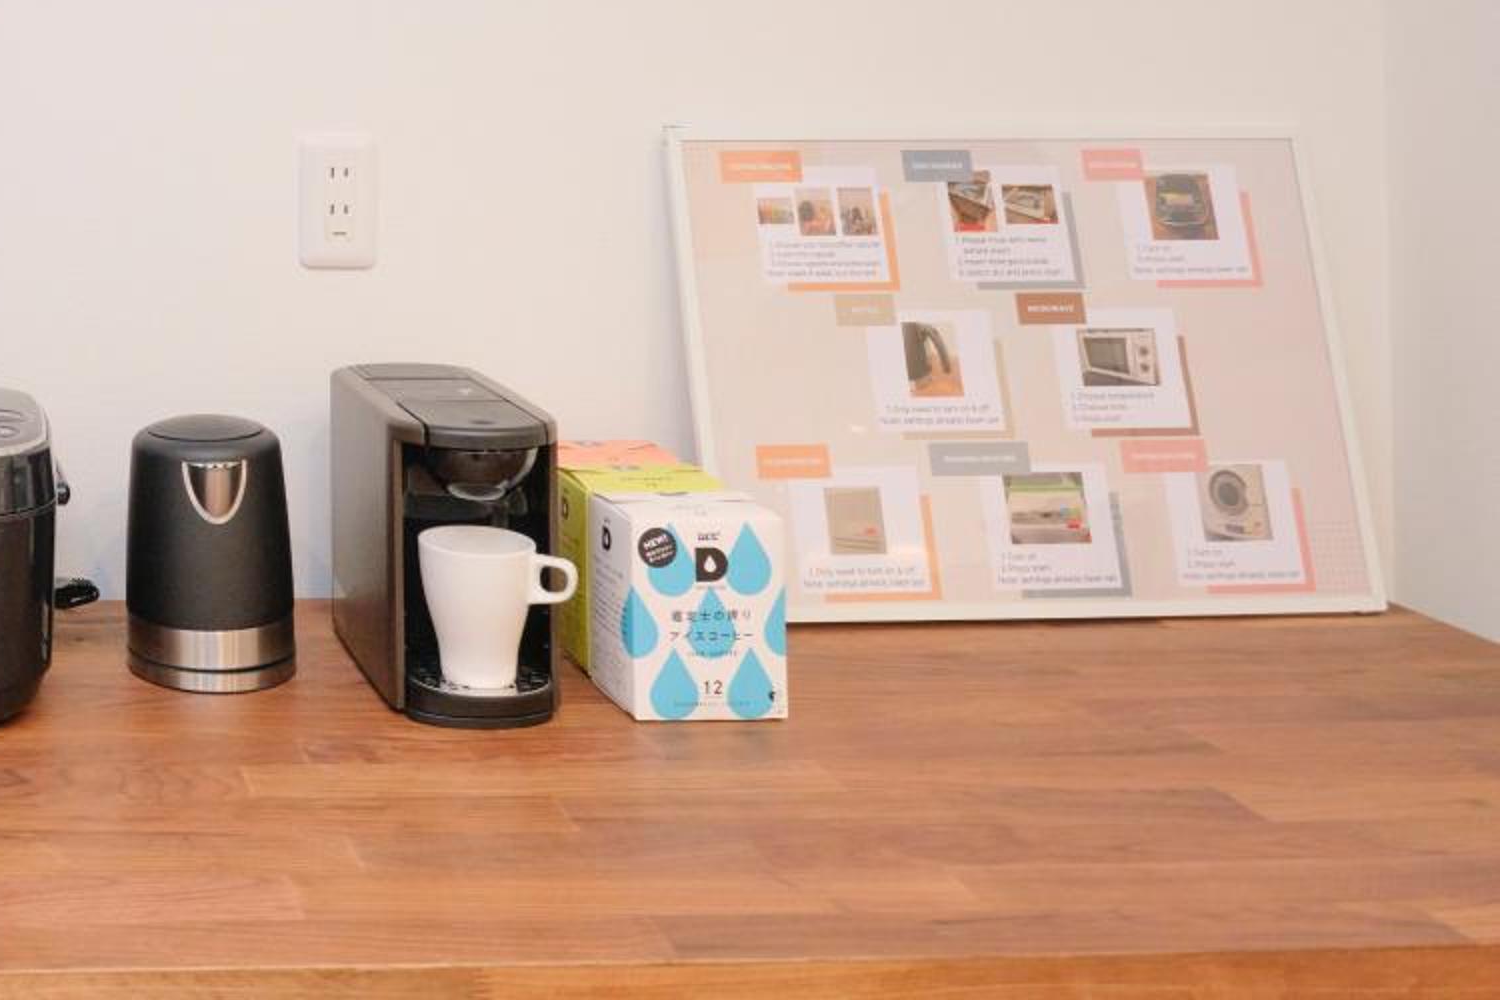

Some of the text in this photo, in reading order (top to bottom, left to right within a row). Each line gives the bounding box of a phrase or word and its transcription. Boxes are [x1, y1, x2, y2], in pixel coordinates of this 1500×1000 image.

[668, 630, 754, 644] アイスコーヒー
[703, 680, 723, 695] 12
